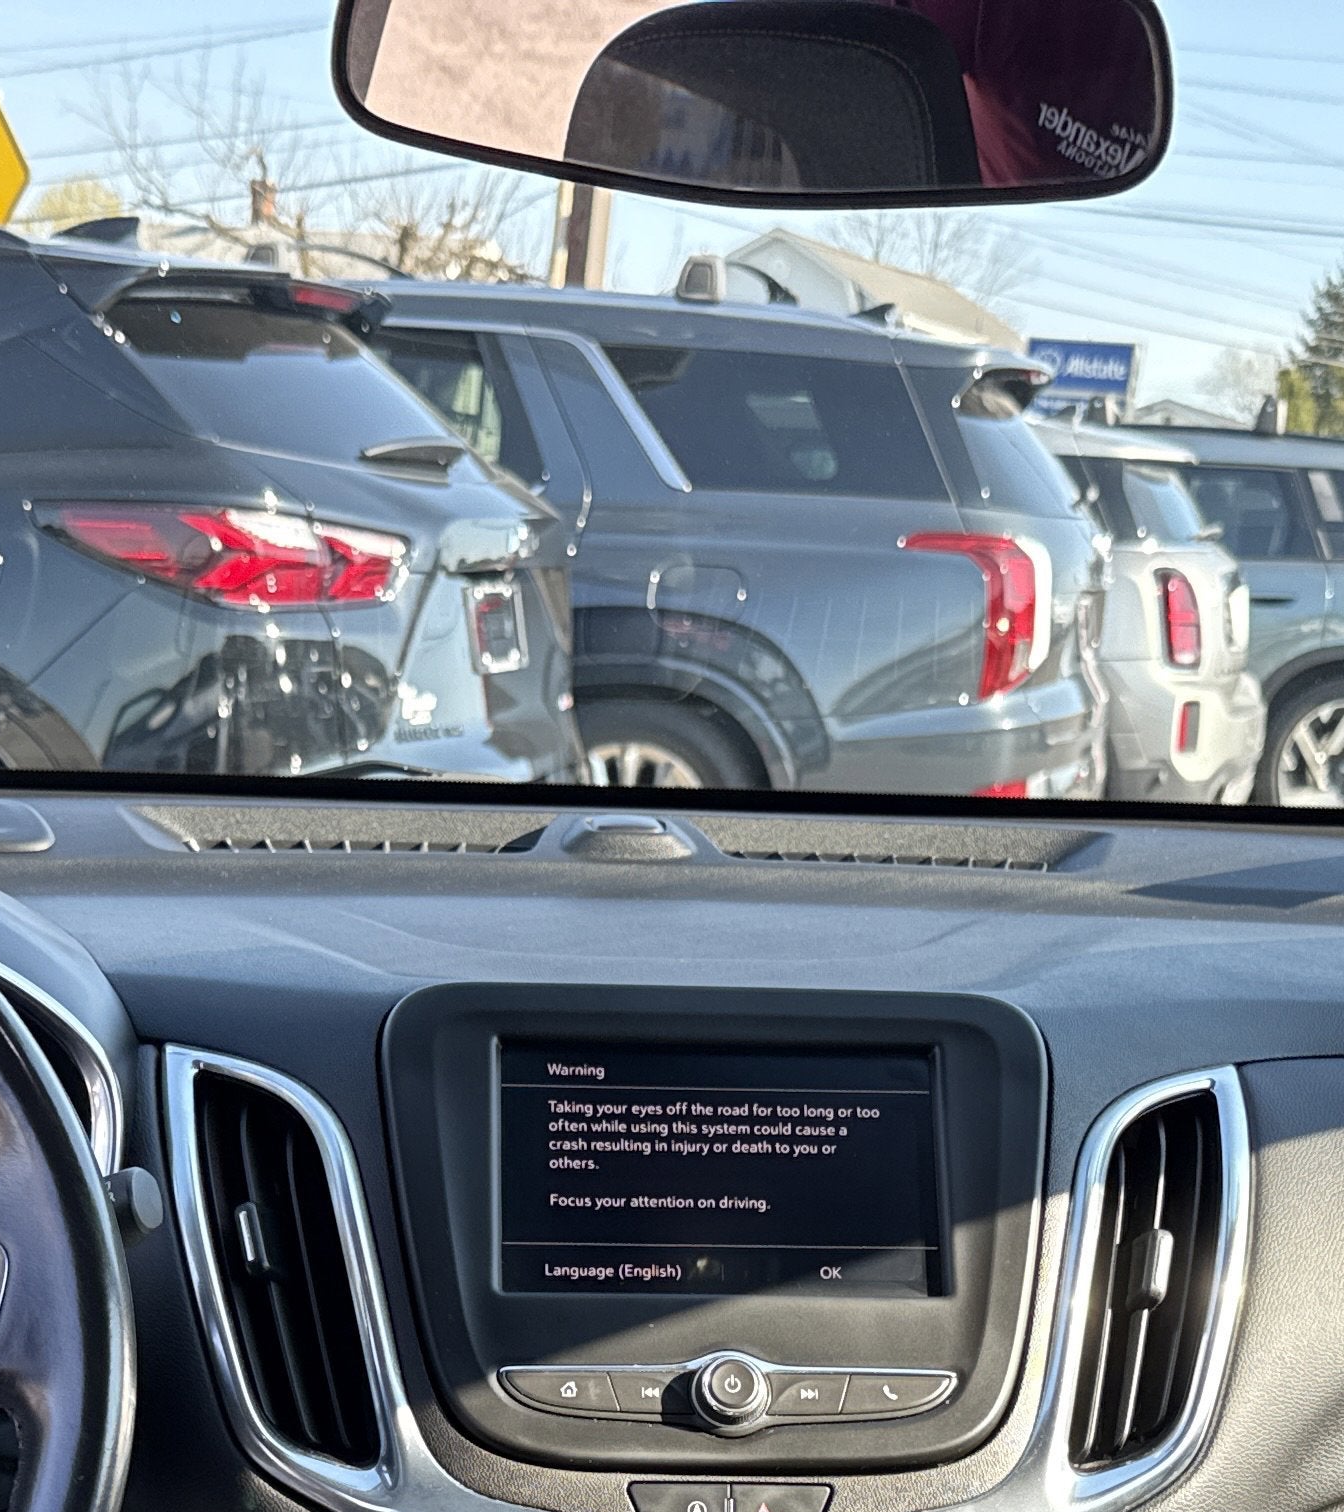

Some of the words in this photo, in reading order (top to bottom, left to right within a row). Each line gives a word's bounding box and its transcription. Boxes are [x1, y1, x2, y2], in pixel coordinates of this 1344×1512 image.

[1064, 353, 1128, 381] Allstate
[547, 1063, 605, 1079] Warning
[548, 1100, 593, 1117] Taking
[596, 1104, 628, 1117] your
[631, 1104, 663, 1117] eyes
[666, 1102, 688, 1115] off
[691, 1102, 713, 1115] the
[717, 1103, 749, 1116] road
[753, 1103, 773, 1117] for
[776, 1105, 800, 1117] too
[803, 1104, 834, 1121] long
[837, 1108, 853, 1118] or
[856, 1106, 880, 1118] too
[548, 1119, 588, 1132] often
[590, 1120, 627, 1132] while
[631, 1121, 669, 1136] using
[672, 1121, 698, 1133] this
[701, 1122, 750, 1137] system
[754, 1122, 792, 1135] could
[795, 1125, 835, 1136] cause
[839, 1126, 848, 1136] a
[548, 1138, 587, 1150] crash
[590, 1138, 651, 1155] resulting
[655, 1139, 668, 1152] in
[671, 1140, 709, 1156] injury
[713, 1142, 729, 1153] or
[731, 1140, 772, 1153] death
[775, 1142, 790, 1154] to
[792, 1144, 818, 1157] you
[821, 1145, 837, 1154] or
[548, 1156, 600, 1170] others.
[549, 1193, 592, 1207] Focus
[594, 1197, 626, 1210] your
[630, 1195, 694, 1209] attention
[697, 1198, 716, 1209] on
[719, 1196, 771, 1212] driving.
[544, 1264, 614, 1281] Language
[618, 1264, 682, 1281] (English)
[819, 1266, 843, 1280] OK
